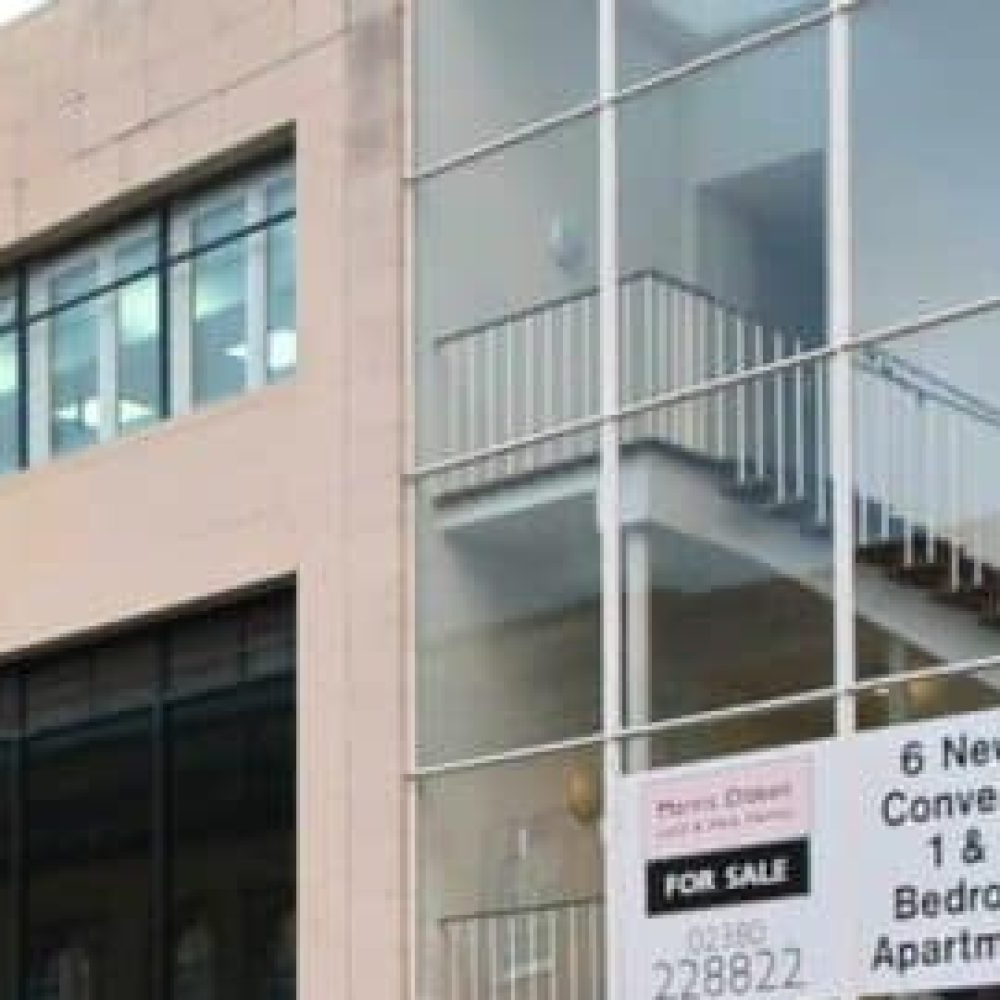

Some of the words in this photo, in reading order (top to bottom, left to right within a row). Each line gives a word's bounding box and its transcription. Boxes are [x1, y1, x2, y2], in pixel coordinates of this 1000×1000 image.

[901, 739, 926, 778] 6
[941, 733, 1000, 771] Ne
[926, 833, 945, 869] 1
[961, 826, 988, 865] &
[664, 866, 716, 903] FOR
[724, 856, 791, 892] SALE
[893, 877, 1000, 922] Bedro
